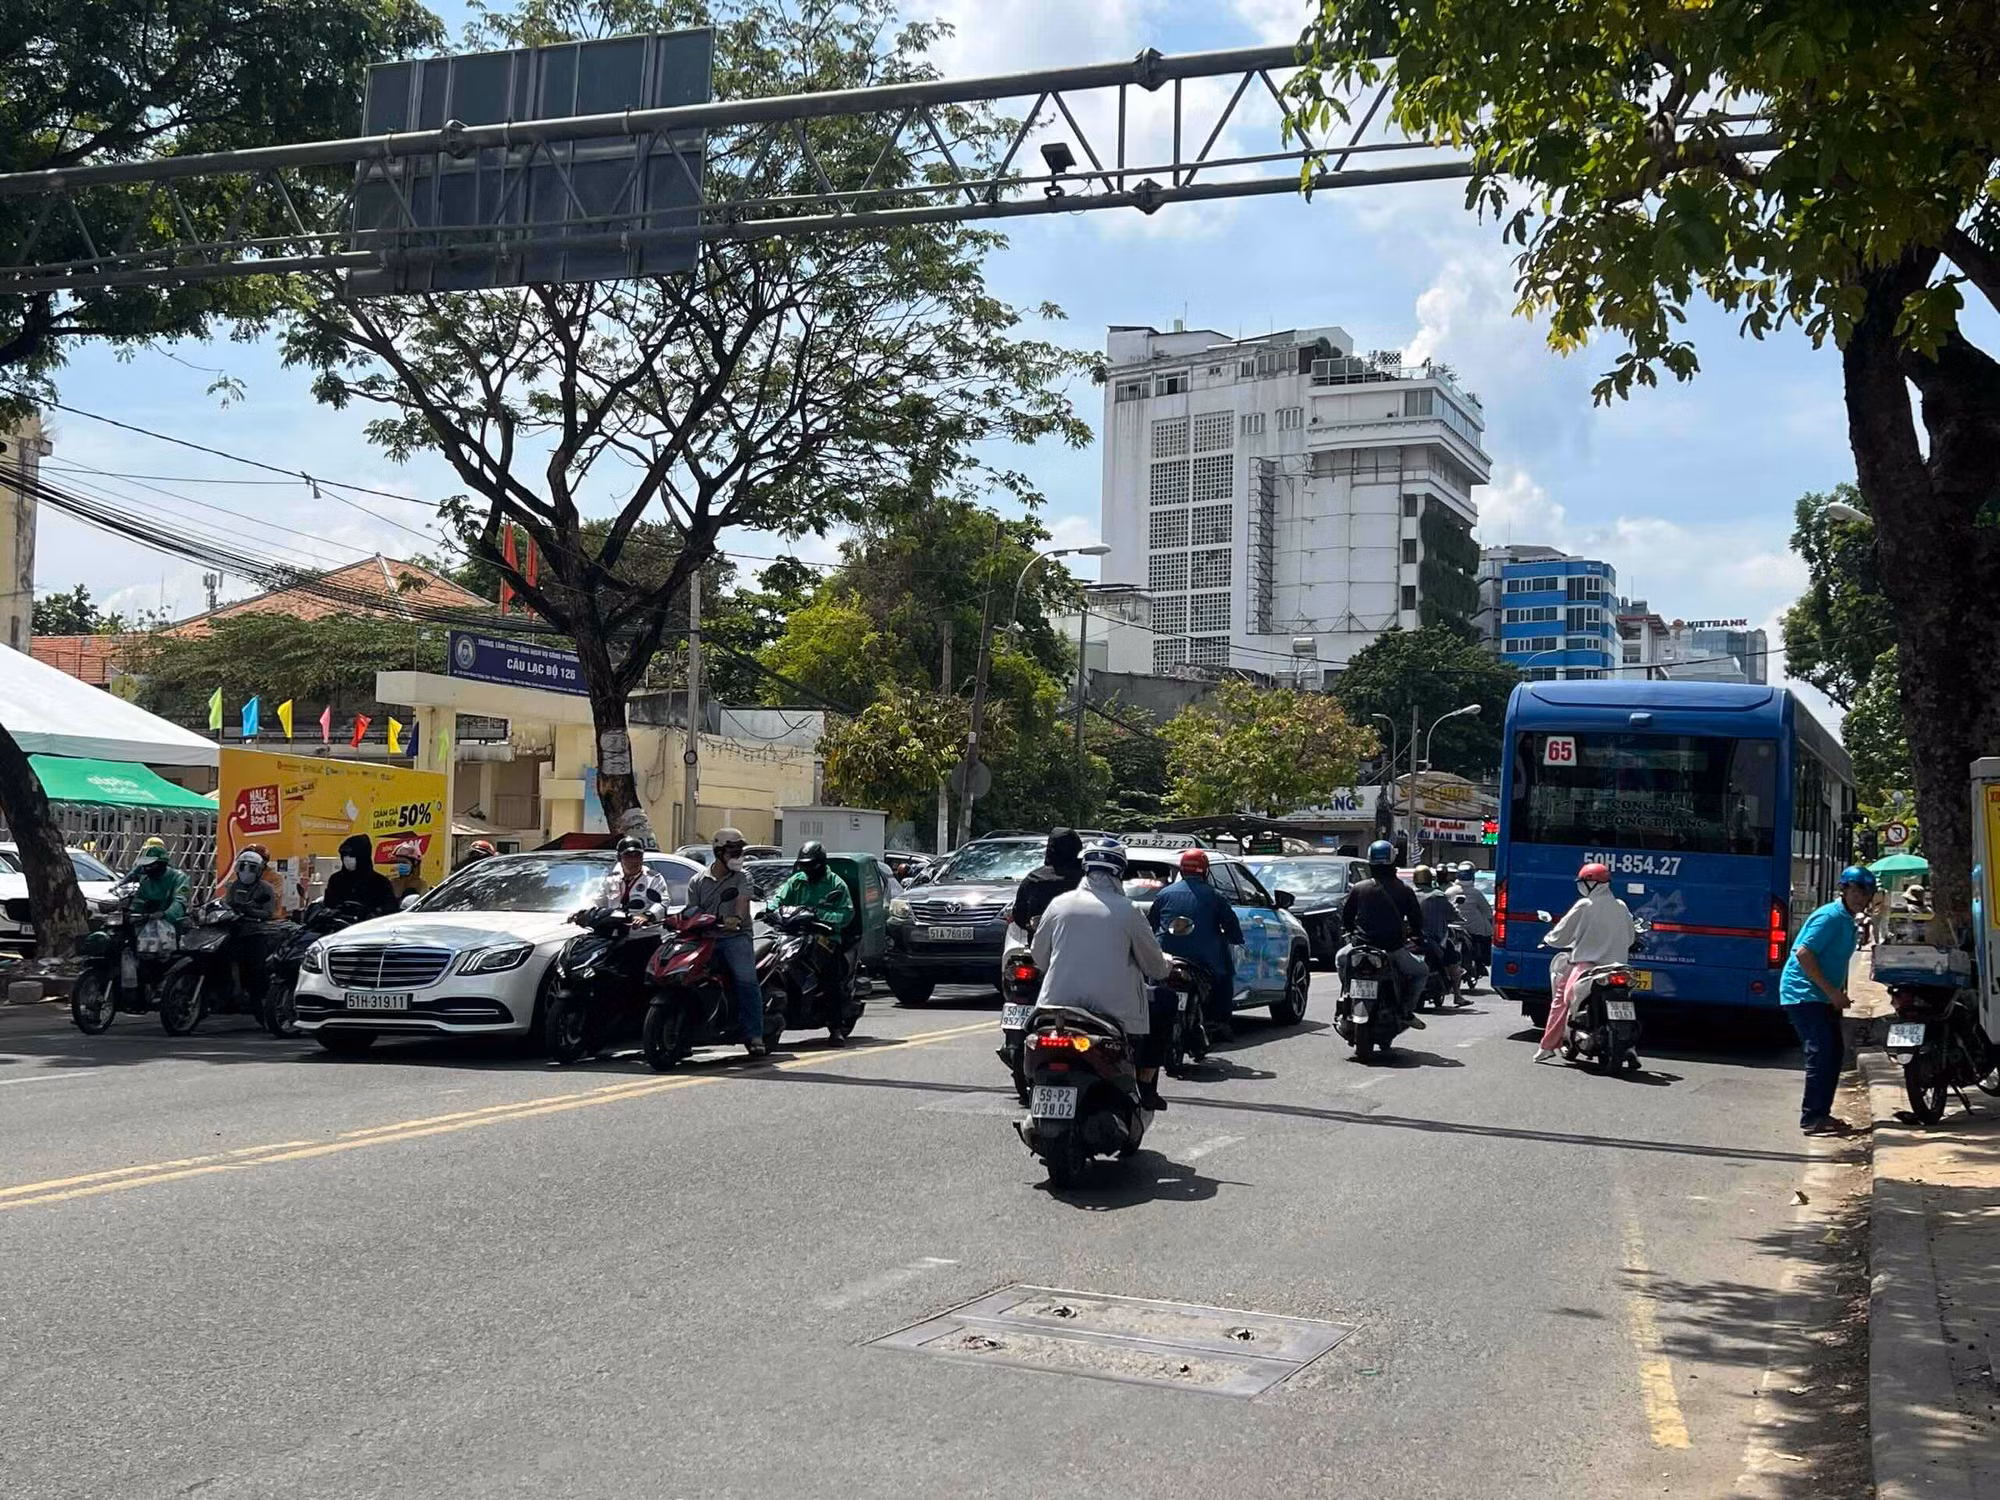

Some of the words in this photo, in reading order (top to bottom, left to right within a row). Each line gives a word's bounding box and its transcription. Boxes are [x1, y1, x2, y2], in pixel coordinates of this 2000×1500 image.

[1687, 619, 1748, 628] VIETBANK
[507, 658, 525, 671] CÂU
[527, 662, 544, 675] LẠC
[546, 664, 558, 679] BỘ
[560, 668, 576, 680] 126
[1548, 741, 1572, 761] 65
[249, 788, 267, 800] HALF
[250, 801, 269, 815] PRICE
[398, 802, 431, 827] 50%
[1152, 839, 1163, 847] 27
[1181, 840, 1193, 848] 27
[348, 994, 404, 1009] 51H-319.11
[1040, 1087, 1071, 1102] 59-P2
